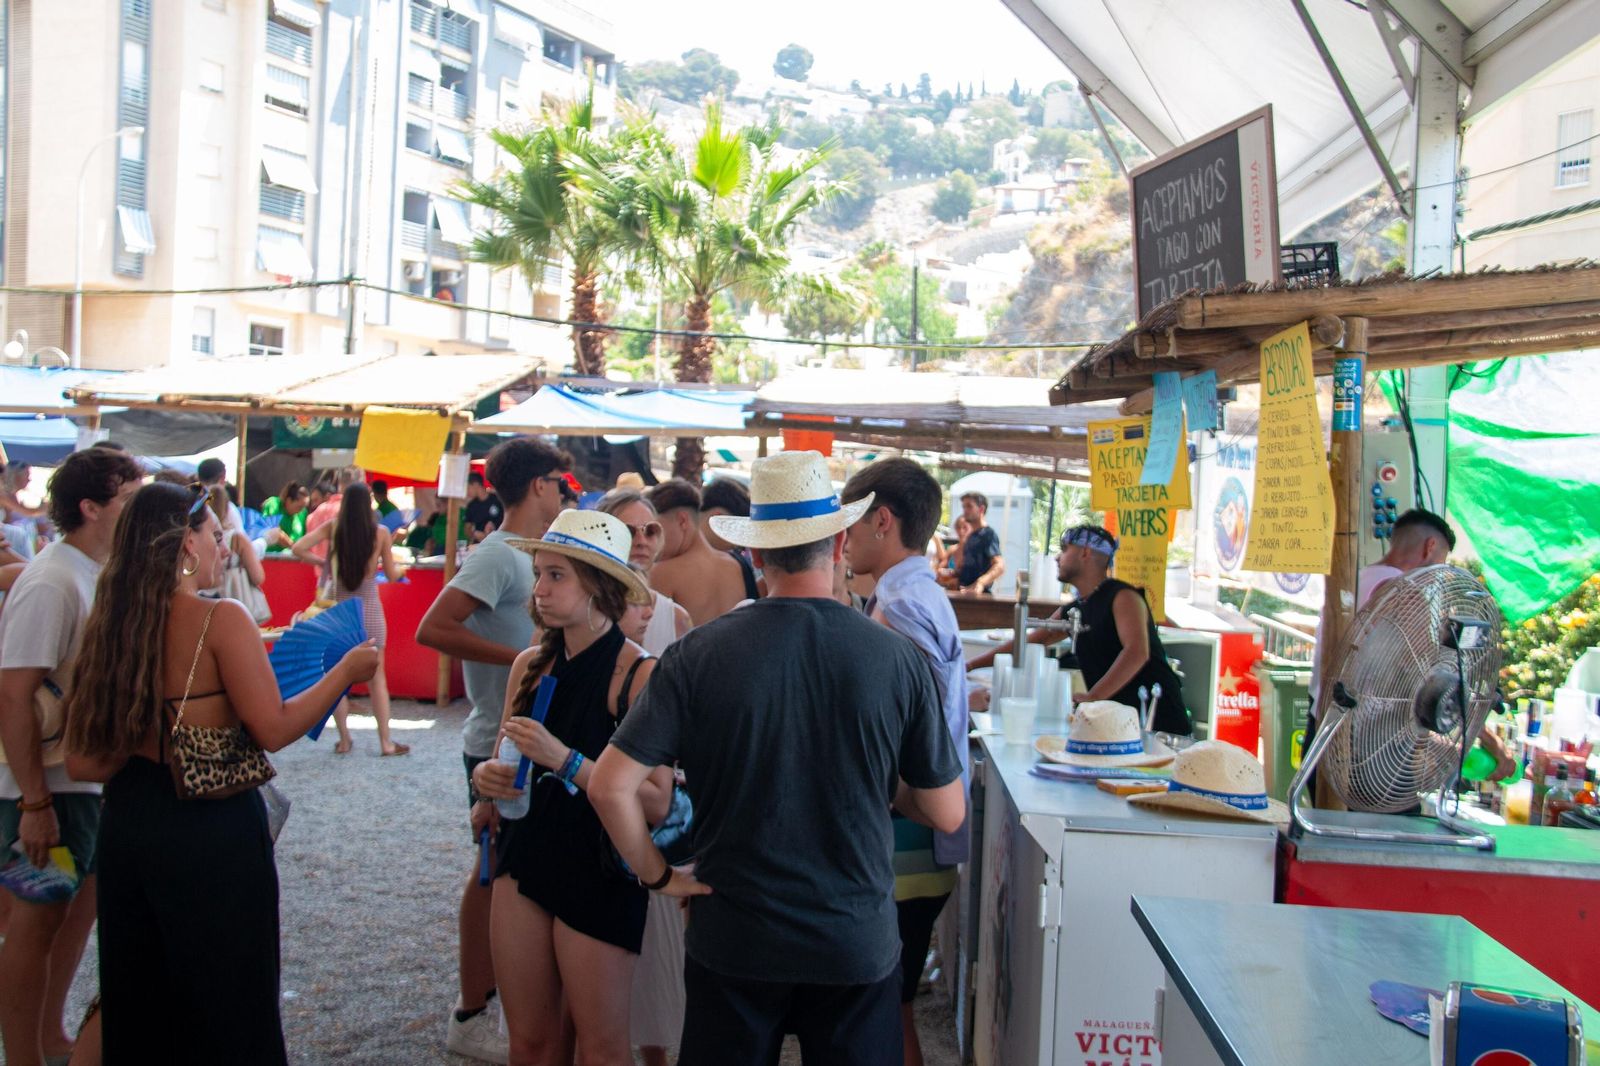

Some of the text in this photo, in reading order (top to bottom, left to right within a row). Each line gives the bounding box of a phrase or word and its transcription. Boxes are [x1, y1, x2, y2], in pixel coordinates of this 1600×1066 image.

[1141, 157, 1228, 239] ACEPTAMOS
[1249, 160, 1264, 261] VICTORIA
[1156, 217, 1222, 269] PAGO CON
[1263, 335, 1306, 397] BEBIDAS
[1103, 472, 1133, 488] PAGO
[1114, 484, 1169, 504] TARJETA
[1116, 507, 1168, 537] VAPERS
[1260, 506, 1308, 520] JARRA CERVEZA
[1271, 521, 1294, 533] TINTO
[1257, 537, 1302, 550] JARRA COPA
[1253, 554, 1273, 567] AGUA
[1083, 1019, 1156, 1030] MALAGUEÑ
[1075, 1031, 1164, 1056] VICT
